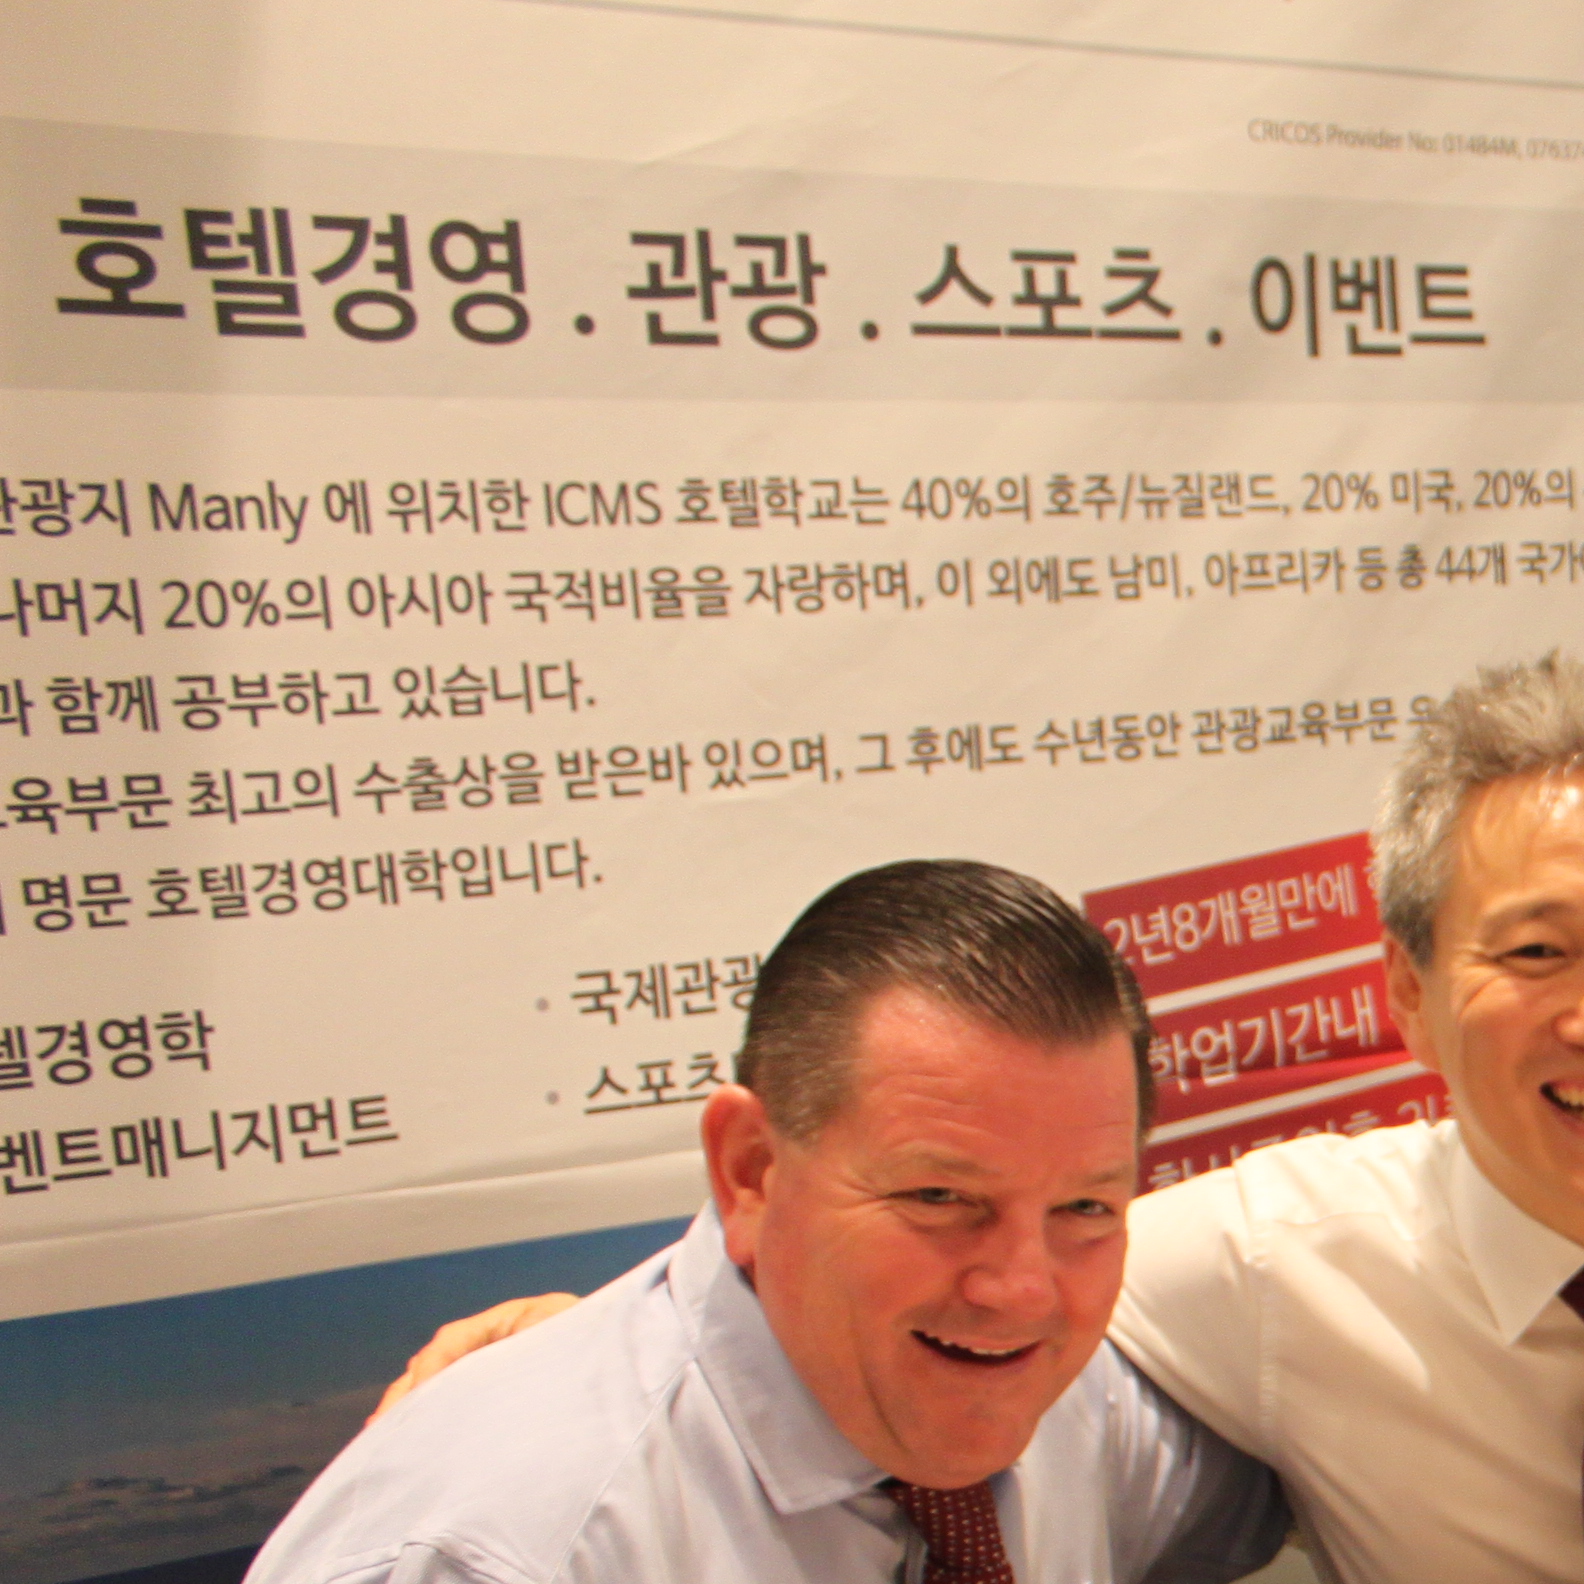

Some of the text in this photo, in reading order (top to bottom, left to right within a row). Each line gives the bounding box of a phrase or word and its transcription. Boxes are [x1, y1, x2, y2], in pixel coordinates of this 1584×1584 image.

[1247, 118, 1321, 145] CRICOS
[1326, 123, 1402, 150] Provider
[56, 197, 531, 345] 호텔경영
[626, 228, 826, 350] 관광
[911, 244, 1182, 342] 스포츠
[1251, 252, 1486, 358] 이벤트
[147, 480, 309, 544] Manly
[323, 479, 371, 534] 에
[387, 477, 529, 534] 위치한
[544, 481, 661, 529] ICMS
[676, 475, 890, 528] 호텔학교는
[901, 477, 1034, 522] 40%의
[1043, 474, 1292, 519] 호주/뉴질랜드,
[1302, 472, 1379, 512] 20%
[1391, 471, 1463, 514] 미국,
[1474, 468, 1574, 509] 20%의
[160, 577, 332, 631] 20%의
[348, 574, 491, 626] 아시아
[503, 565, 731, 621] 국적비율을
[744, 561, 923, 613] 자랑하며,
[938, 558, 973, 605] 이
[987, 554, 1101, 603] 외에도
[1203, 545, 1346, 595] 아프리카
[1353, 547, 1387, 591] 등
[1398, 544, 1427, 588] 총
[1435, 543, 1508, 585] 44개
[46, 676, 159, 733] 함께
[171, 669, 380, 728] 공부하고
[392, 662, 596, 721] 있습니다.
[0, 771, 172, 834] 육부문
[188, 762, 339, 823] 최고의
[353, 751, 545, 813] 수출상을
[557, 742, 693, 799] 받은바
[705, 734, 842, 792] 있으며,
[856, 732, 896, 776] 그
[906, 720, 1024, 773] 후에도
[1034, 711, 1181, 767] 수년동안
[1191, 697, 1397, 755] 관광교육부문
[22, 870, 131, 933] 명문
[147, 837, 601, 919] 호텔경영대학입니다.
[1103, 863, 1358, 966] 2년8개월만에
[1147, 984, 1379, 1095] 학업기간내
